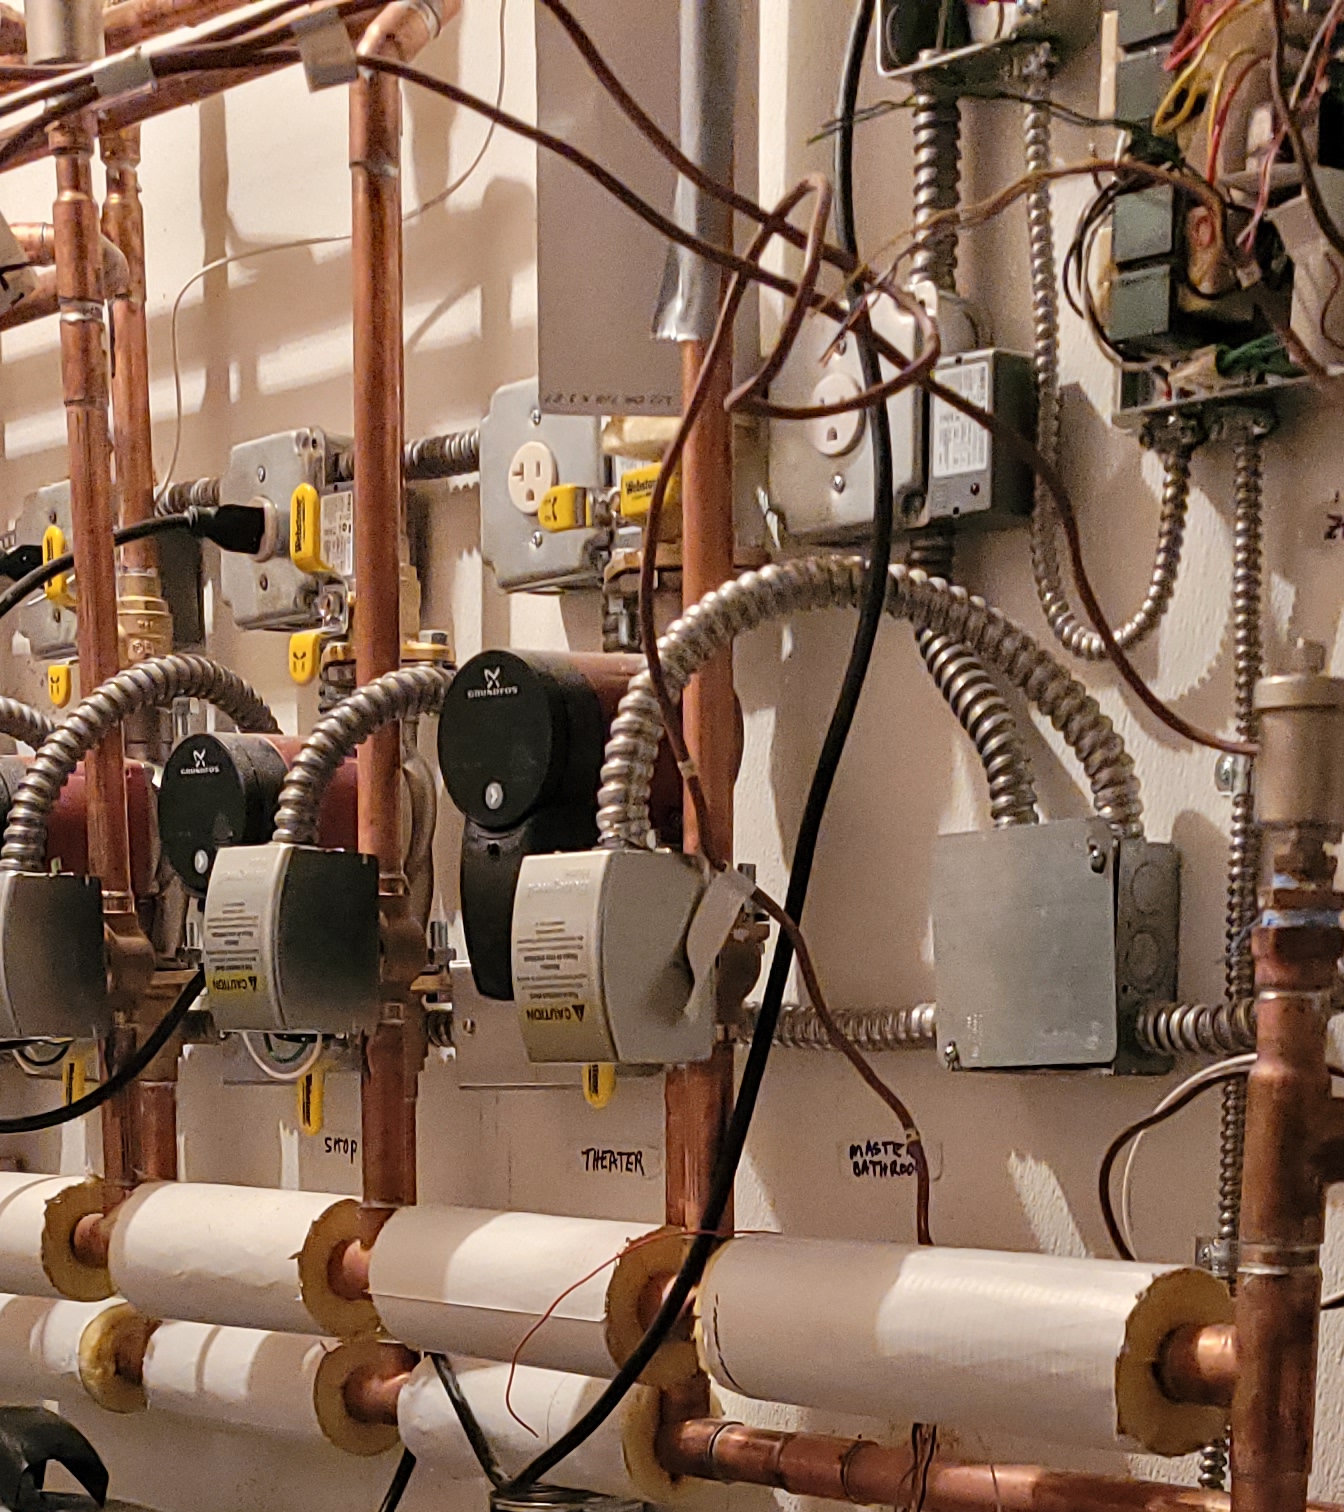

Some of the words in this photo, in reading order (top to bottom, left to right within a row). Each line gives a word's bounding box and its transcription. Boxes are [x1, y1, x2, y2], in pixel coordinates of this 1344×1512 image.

[526, 1006, 572, 1022] CAUTION
[849, 1139, 910, 1160] MASTE
[581, 1147, 645, 1176] THEATER
[852, 1158, 918, 1178] BATHROO
